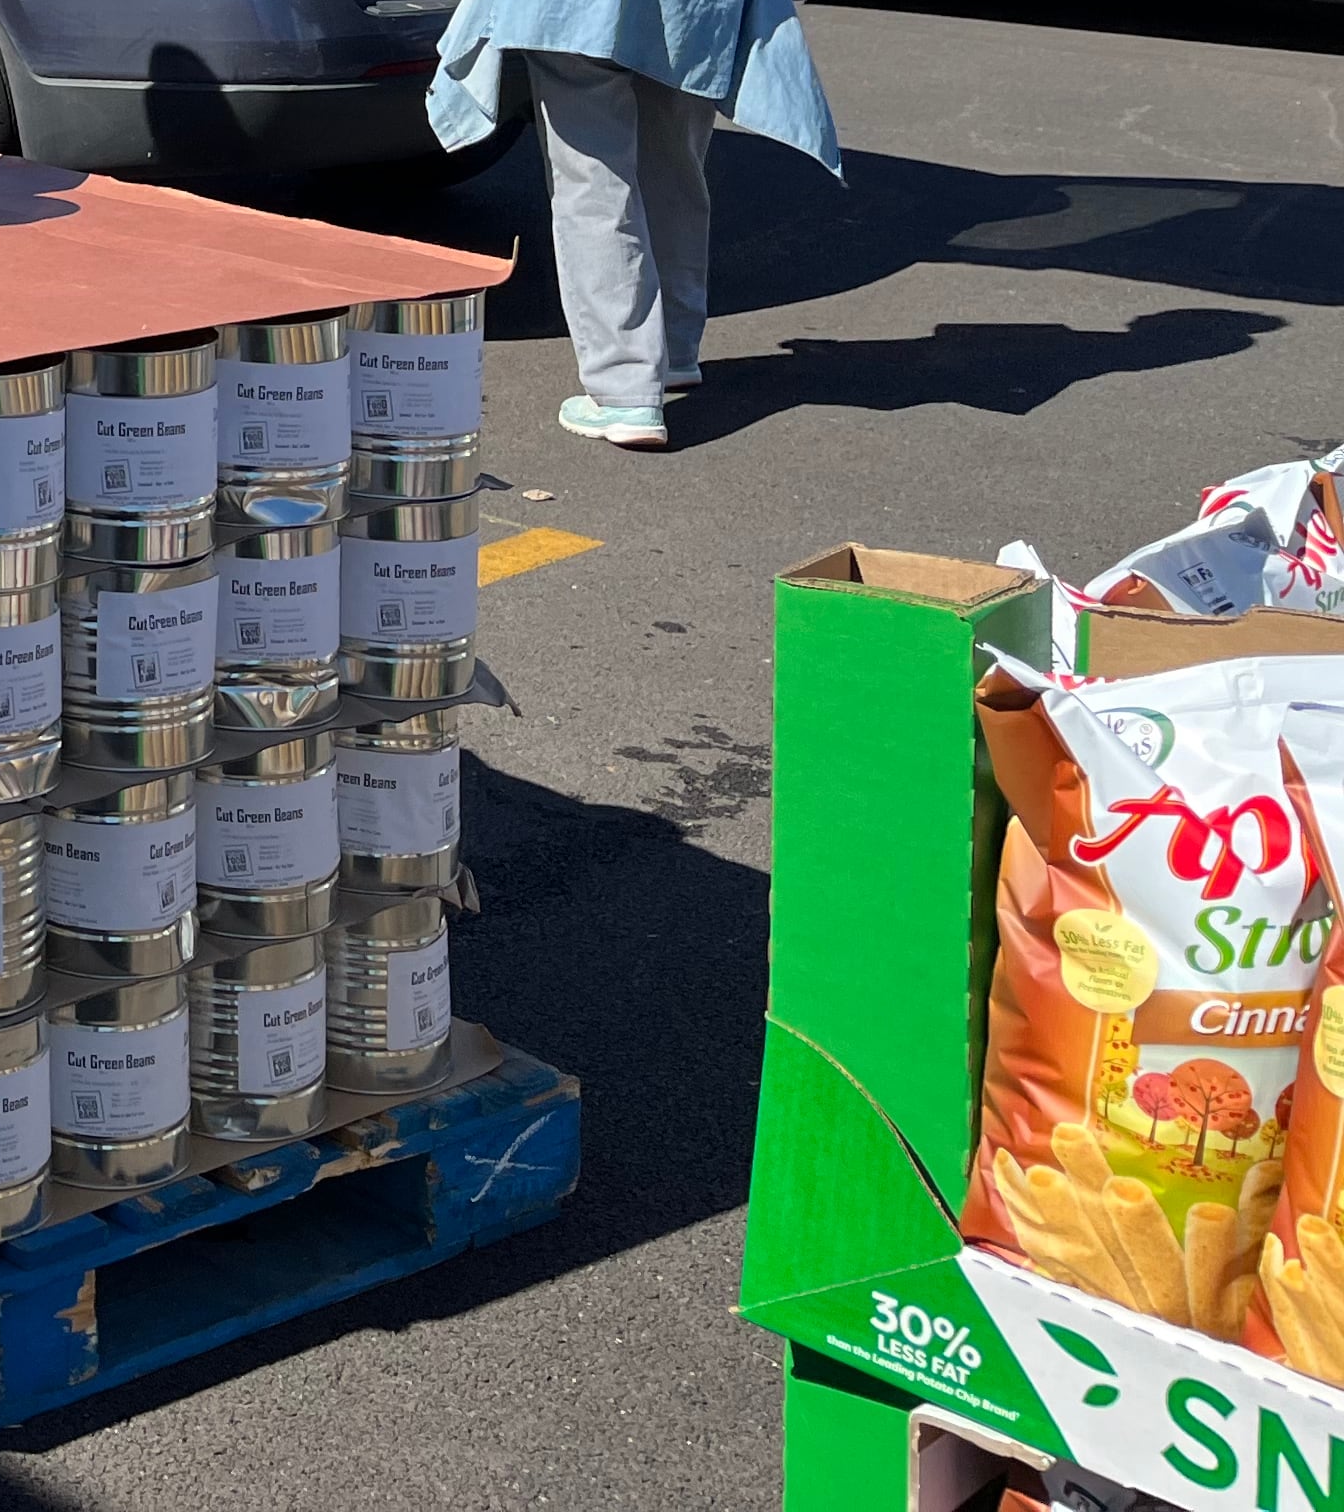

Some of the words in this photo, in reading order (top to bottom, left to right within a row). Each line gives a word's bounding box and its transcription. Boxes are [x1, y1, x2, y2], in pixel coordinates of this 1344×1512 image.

[359, 353, 380, 369] Cut
[383, 355, 415, 371] Green
[418, 356, 449, 372] Beans
[237, 384, 255, 399] Cut
[257, 387, 293, 402] Green
[296, 387, 324, 402] Beans
[97, 420, 115, 437] Cut
[118, 421, 154, 438] Green
[157, 421, 186, 436] Beans
[373, 563, 391, 578] Cut
[394, 565, 427, 579] Green
[430, 563, 456, 578] Beans
[231, 579, 251, 595] Cut
[255, 582, 286, 598] Green
[289, 580, 318, 596] Beans
[128, 616, 148, 632] Cut
[149, 614, 178, 630] Green
[180, 609, 203, 626] Beans
[5, 649, 34, 666] Green
[35, 643, 54, 661] Beans
[363, 774, 397, 790] Beans
[216, 807, 234, 824] Cut
[236, 808, 271, 824] Green
[275, 807, 304, 823] Beans
[1092, 934, 1119, 948] Less
[1124, 940, 1145, 955] Fat
[68, 1052, 86, 1068] Cut
[89, 1053, 124, 1070] Green
[126, 1054, 156, 1069] Beans
[2, 1096, 29, 1114] Beans
[870, 1291, 982, 1369] 30%
[878, 1334, 927, 1368] LESS
[931, 1356, 970, 1385] FAT
[827, 1335, 852, 1351] than
[853, 1345, 871, 1361] the
[873, 1355, 915, 1381] Leading
[917, 1372, 954, 1395] Potato
[955, 1389, 981, 1408] Chip
